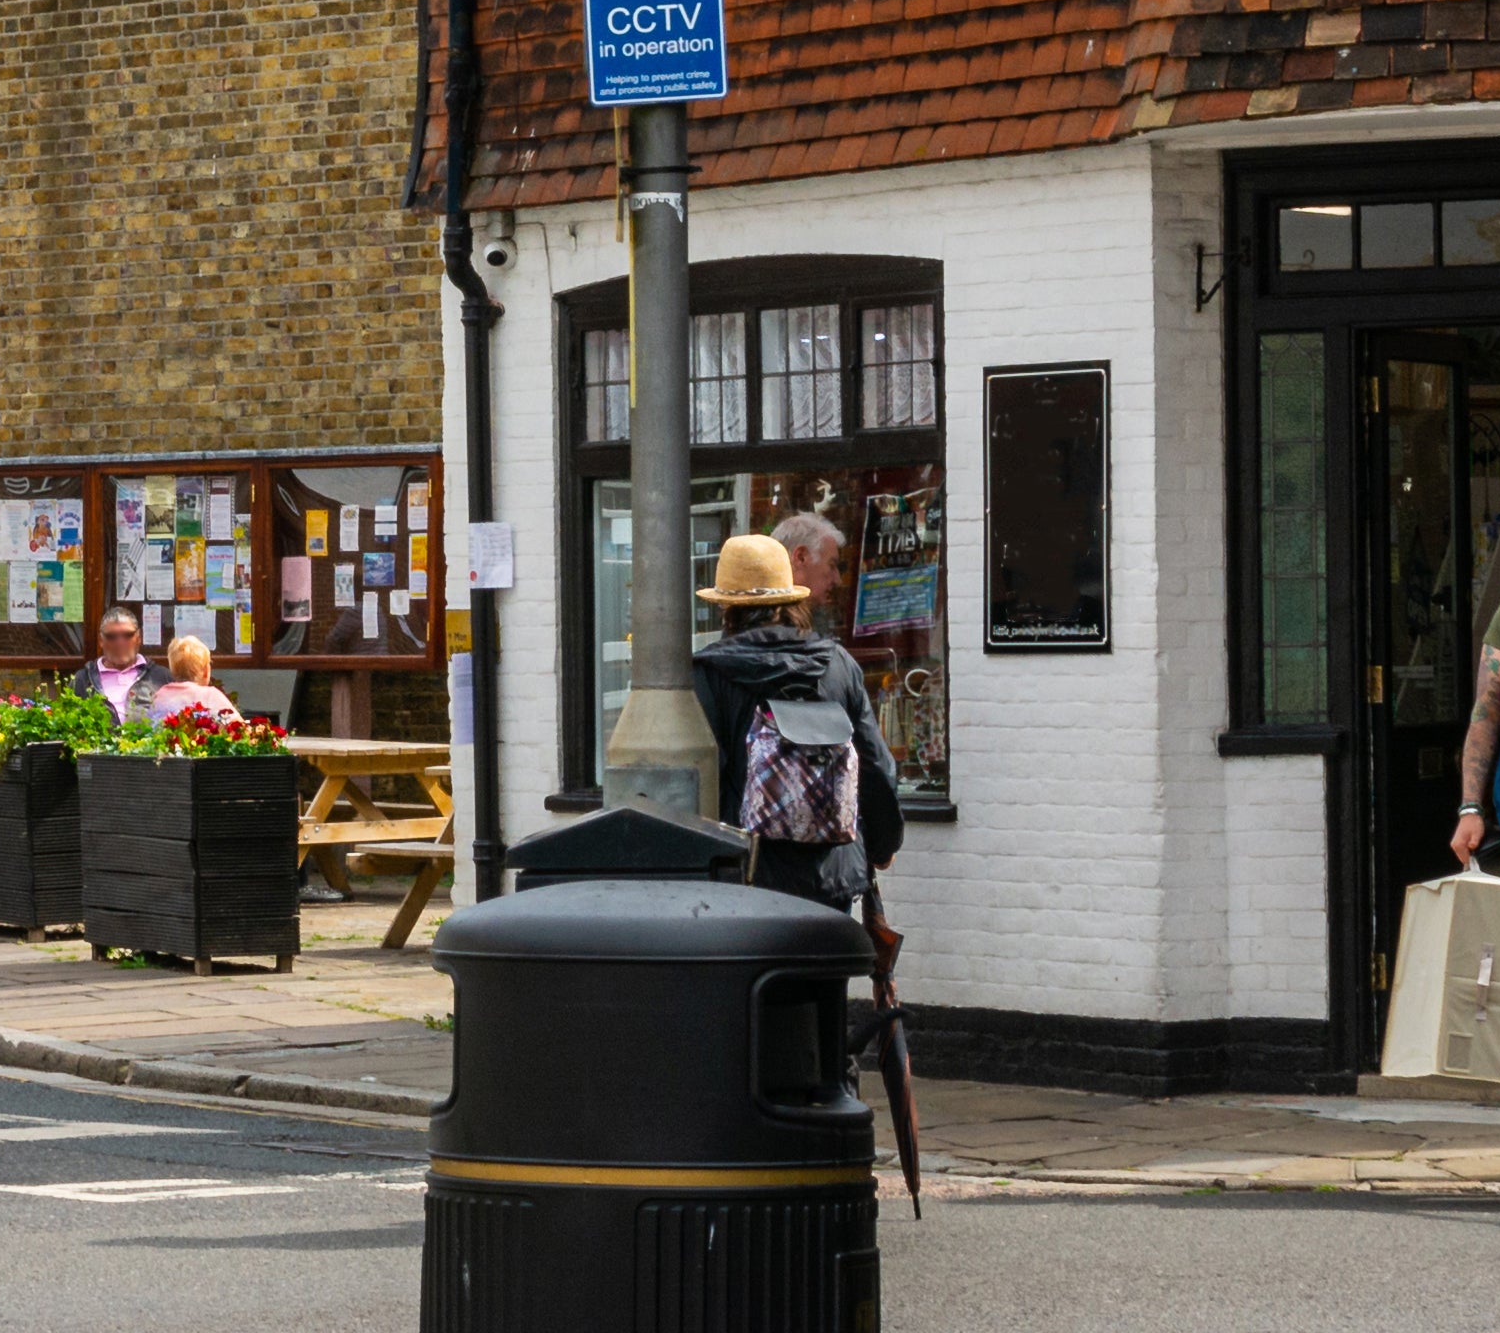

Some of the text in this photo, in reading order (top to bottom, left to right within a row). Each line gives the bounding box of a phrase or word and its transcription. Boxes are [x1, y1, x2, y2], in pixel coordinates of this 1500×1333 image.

[607, 3, 702, 35] CCTV
[599, 36, 714, 59] in operation
[605, 70, 710, 86] Helping to prevent crime
[600, 80, 718, 96] and promoting public safety
